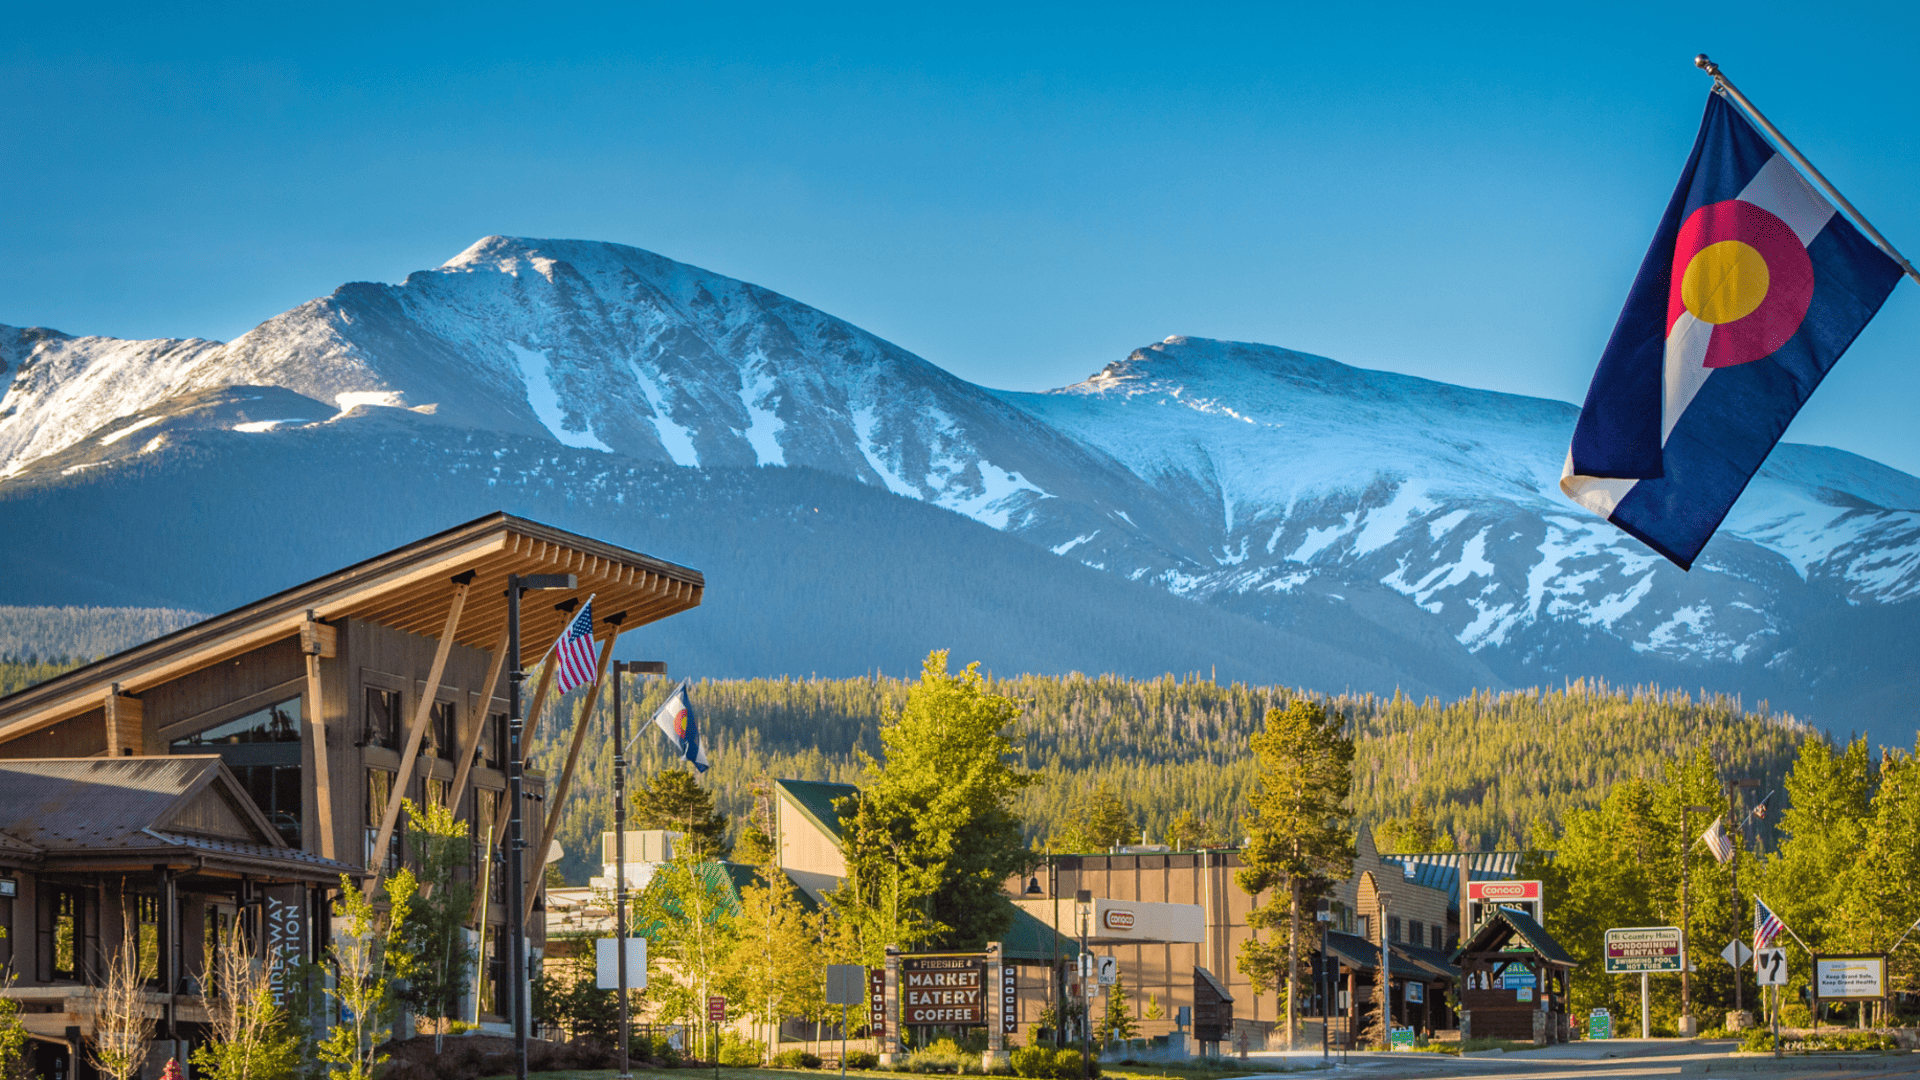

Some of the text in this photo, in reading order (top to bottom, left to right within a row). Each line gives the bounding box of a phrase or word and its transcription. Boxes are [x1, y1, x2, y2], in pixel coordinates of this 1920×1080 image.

[1485, 886, 1521, 895] conoco
[1110, 915, 1133, 923] conoco
[1622, 932, 1654, 941] Country
[1611, 941, 1677, 950] CONDOMINIUM
[268, 896, 285, 1006] HIDEAWAY
[1623, 947, 1665, 956] RENTALS
[920, 959, 965, 969] FIRESIDE
[1615, 957, 1653, 965] SWIMMING
[908, 972, 978, 987] MARKET
[908, 990, 978, 1005] EATERY
[1004, 967, 1015, 1032] GROCERY
[872, 976, 883, 1031] LIQUOR
[913, 1008, 972, 1021] COFFEE
